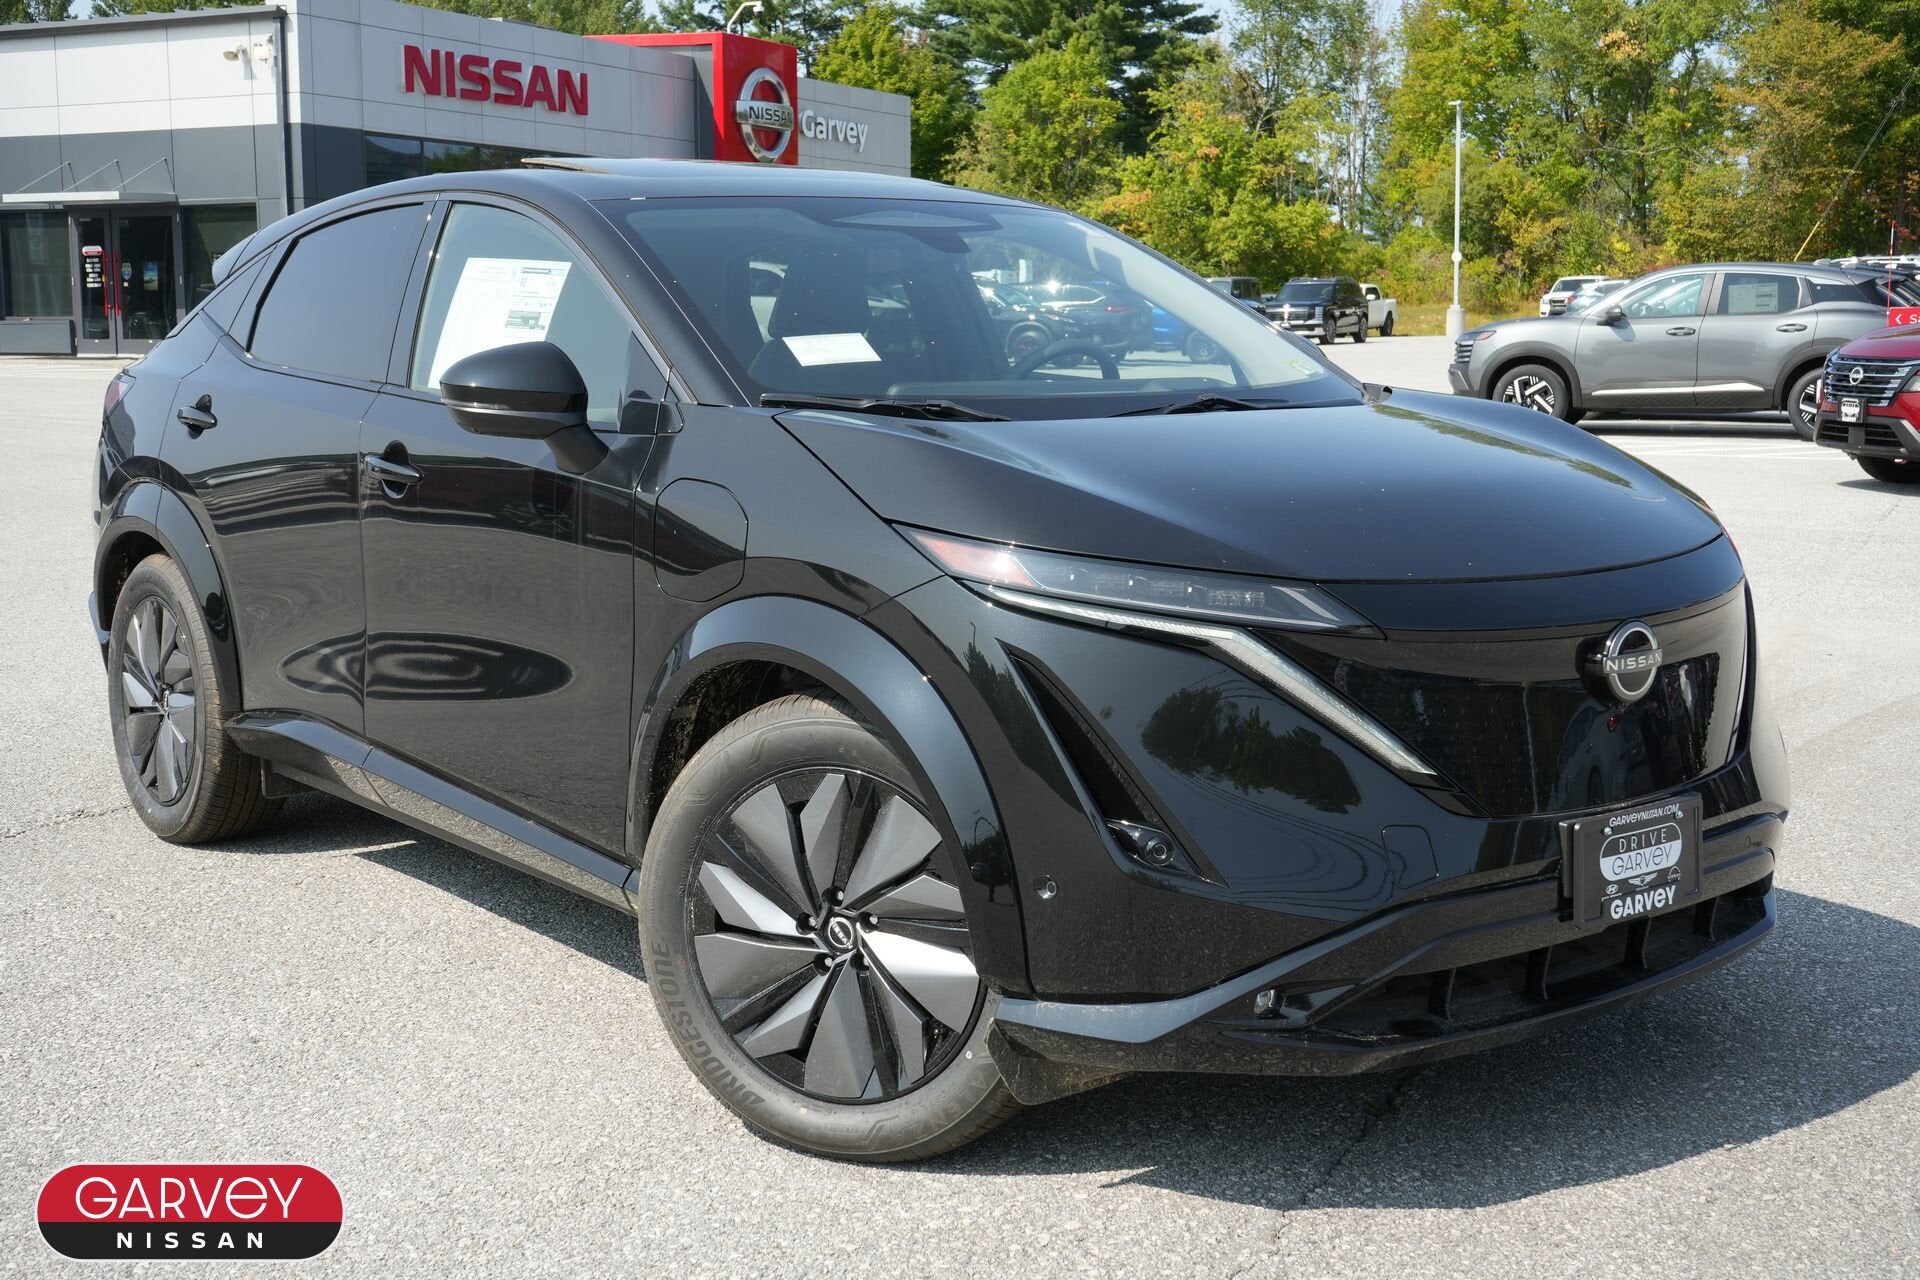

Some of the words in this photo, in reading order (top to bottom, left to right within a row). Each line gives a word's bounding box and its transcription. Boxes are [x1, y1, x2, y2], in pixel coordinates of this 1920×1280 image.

[403, 44, 589, 116] NISSAN
[801, 109, 868, 152] Garvey
[1606, 653, 1662, 671] NISSAN
[1620, 829, 1667, 853] DRIVE
[1612, 844, 1673, 876] GARVEY
[1610, 885, 1676, 919] GARVEY
[650, 940, 767, 1108] BRIDGESTONE
